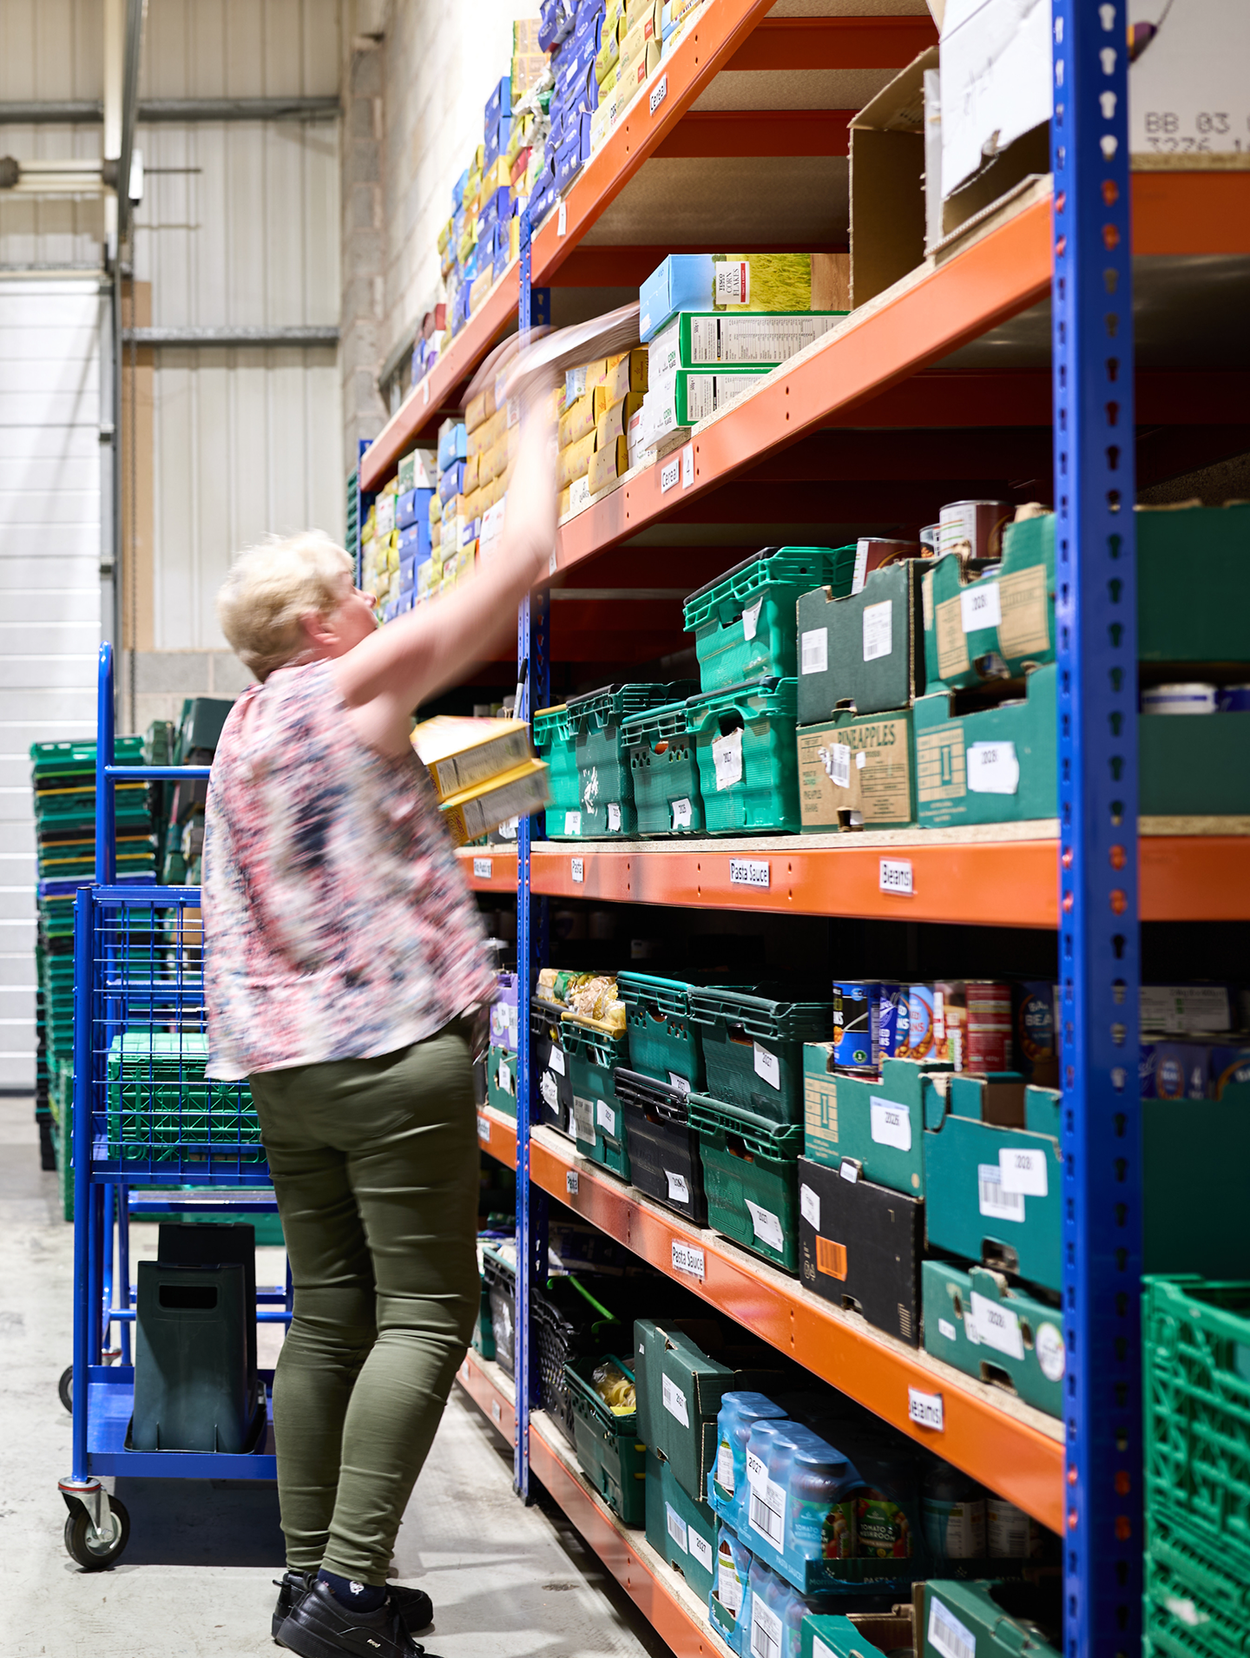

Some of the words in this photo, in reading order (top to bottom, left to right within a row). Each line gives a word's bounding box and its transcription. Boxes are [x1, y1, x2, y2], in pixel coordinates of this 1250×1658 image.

[650, 85, 664, 111] Cereal
[1145, 112, 1180, 134] BB
[662, 470, 677, 490] Cereal
[837, 723, 896, 751] PINEAPPLES
[731, 863, 748, 881] Pasta
[749, 865, 768, 883] Sauce
[883, 864, 910, 886] Beans
[673, 1246, 687, 1266] Pasta
[687, 1250, 703, 1271] Sauce
[910, 1400, 941, 1424] eans
[748, 1456, 762, 1476] 2027
[795, 1523, 819, 1534] TOMATO
[860, 1523, 886, 1533] TOMATO
[860, 1531, 896, 1542] MUSHROOM
[696, 1537, 707, 1554] 2027
